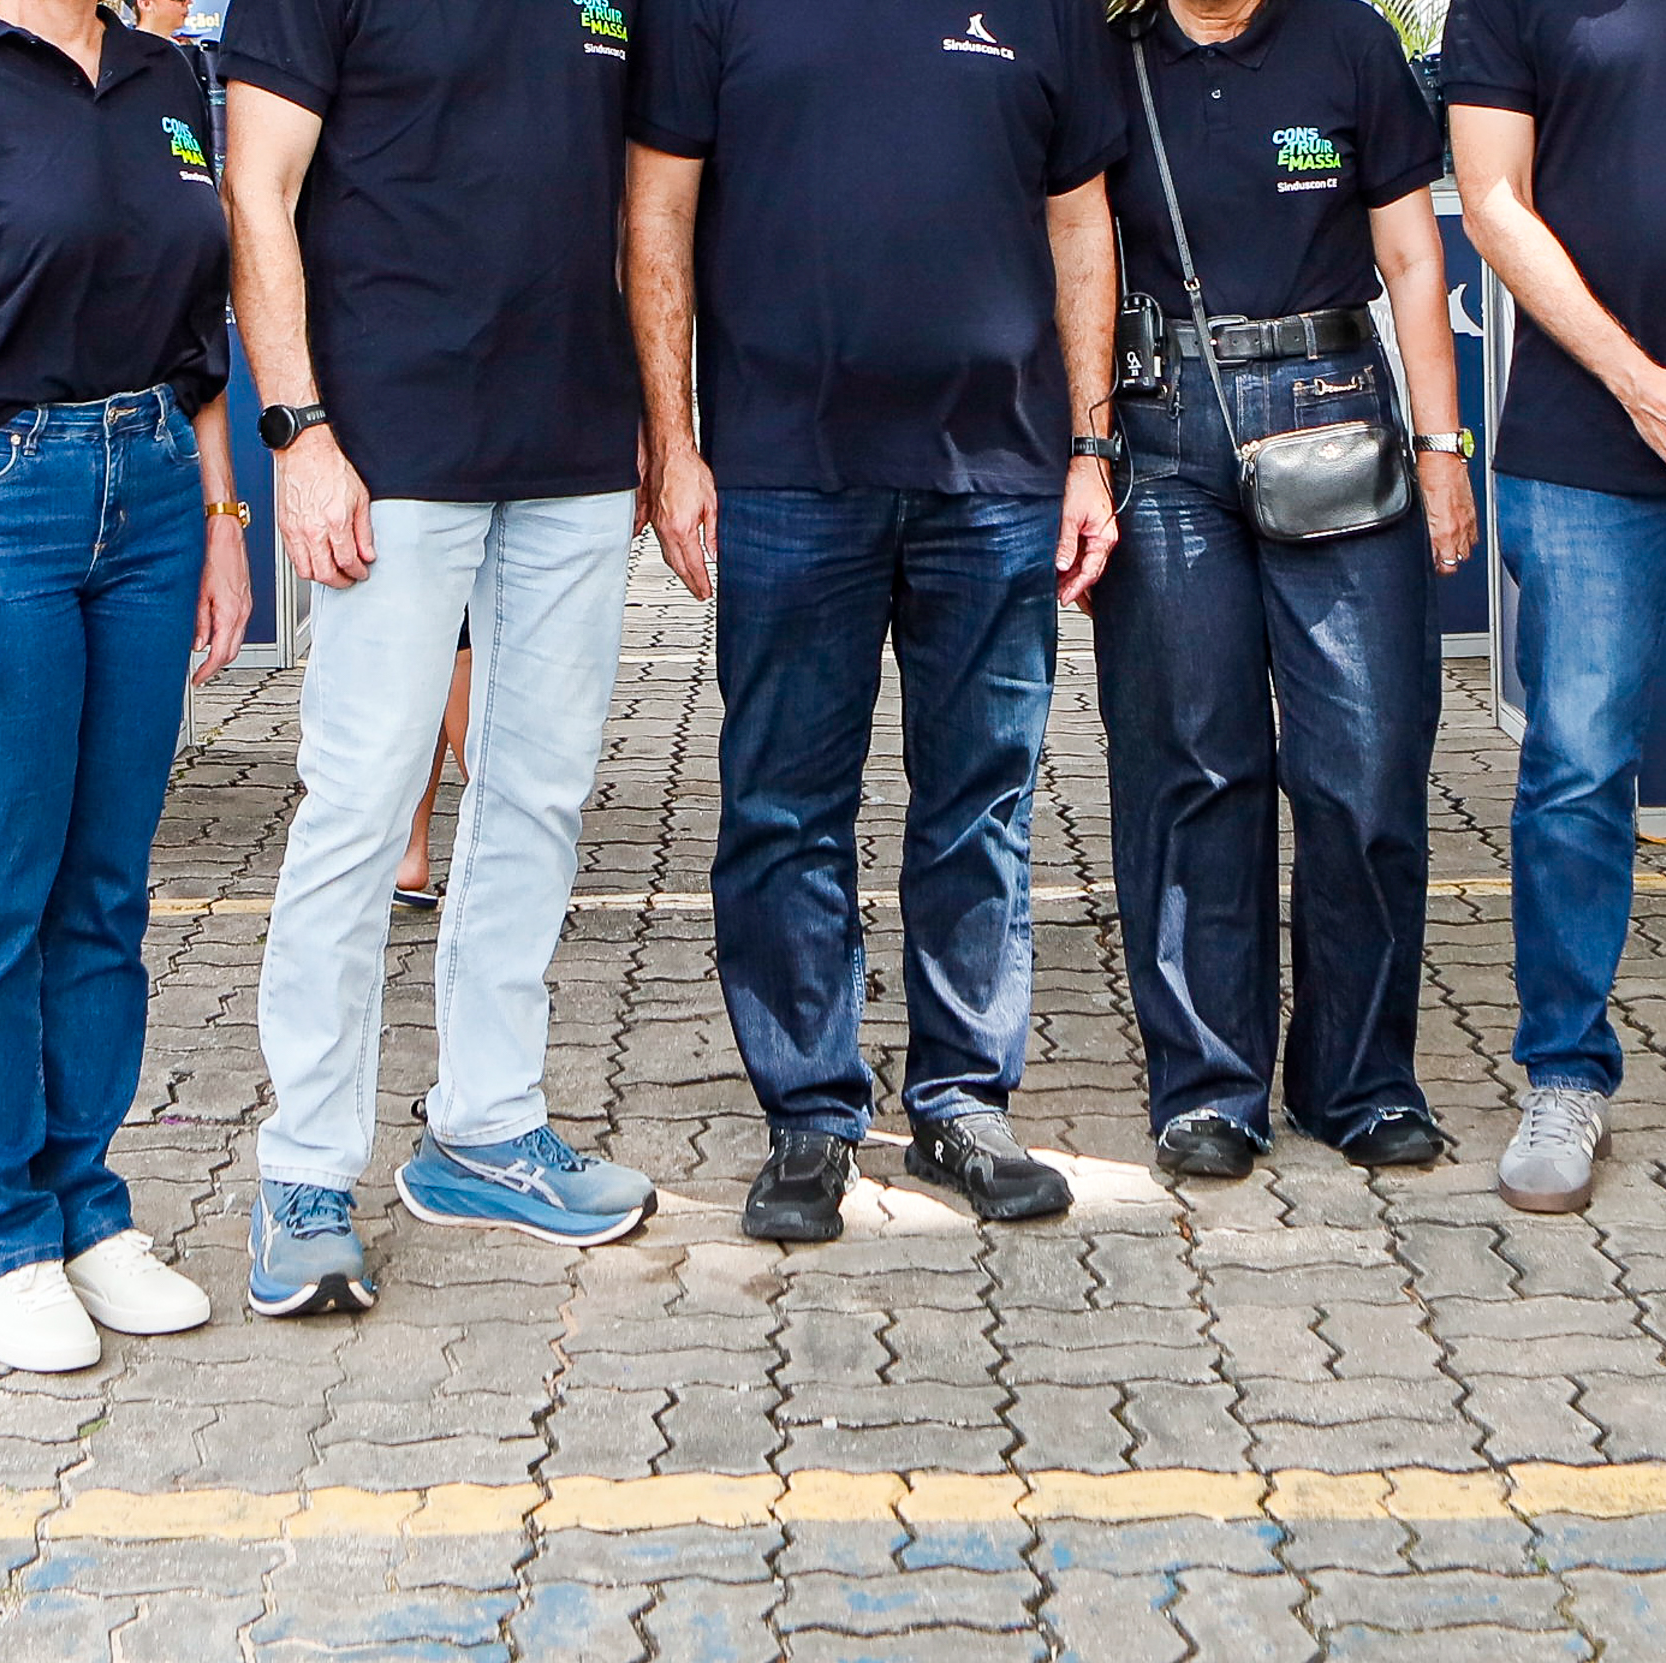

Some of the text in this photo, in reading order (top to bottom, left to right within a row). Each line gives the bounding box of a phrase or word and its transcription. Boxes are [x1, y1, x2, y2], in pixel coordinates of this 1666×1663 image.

[590, 19, 629, 42] MASSA
[943, 39, 1000, 56] Sinduscon
[174, 133, 201, 152] TRU
[1272, 126, 1320, 145] CONS
[1287, 138, 1334, 155] TRUIR
[1288, 153, 1342, 172] MASSA
[1276, 178, 1338, 193] Sinduscon CE
